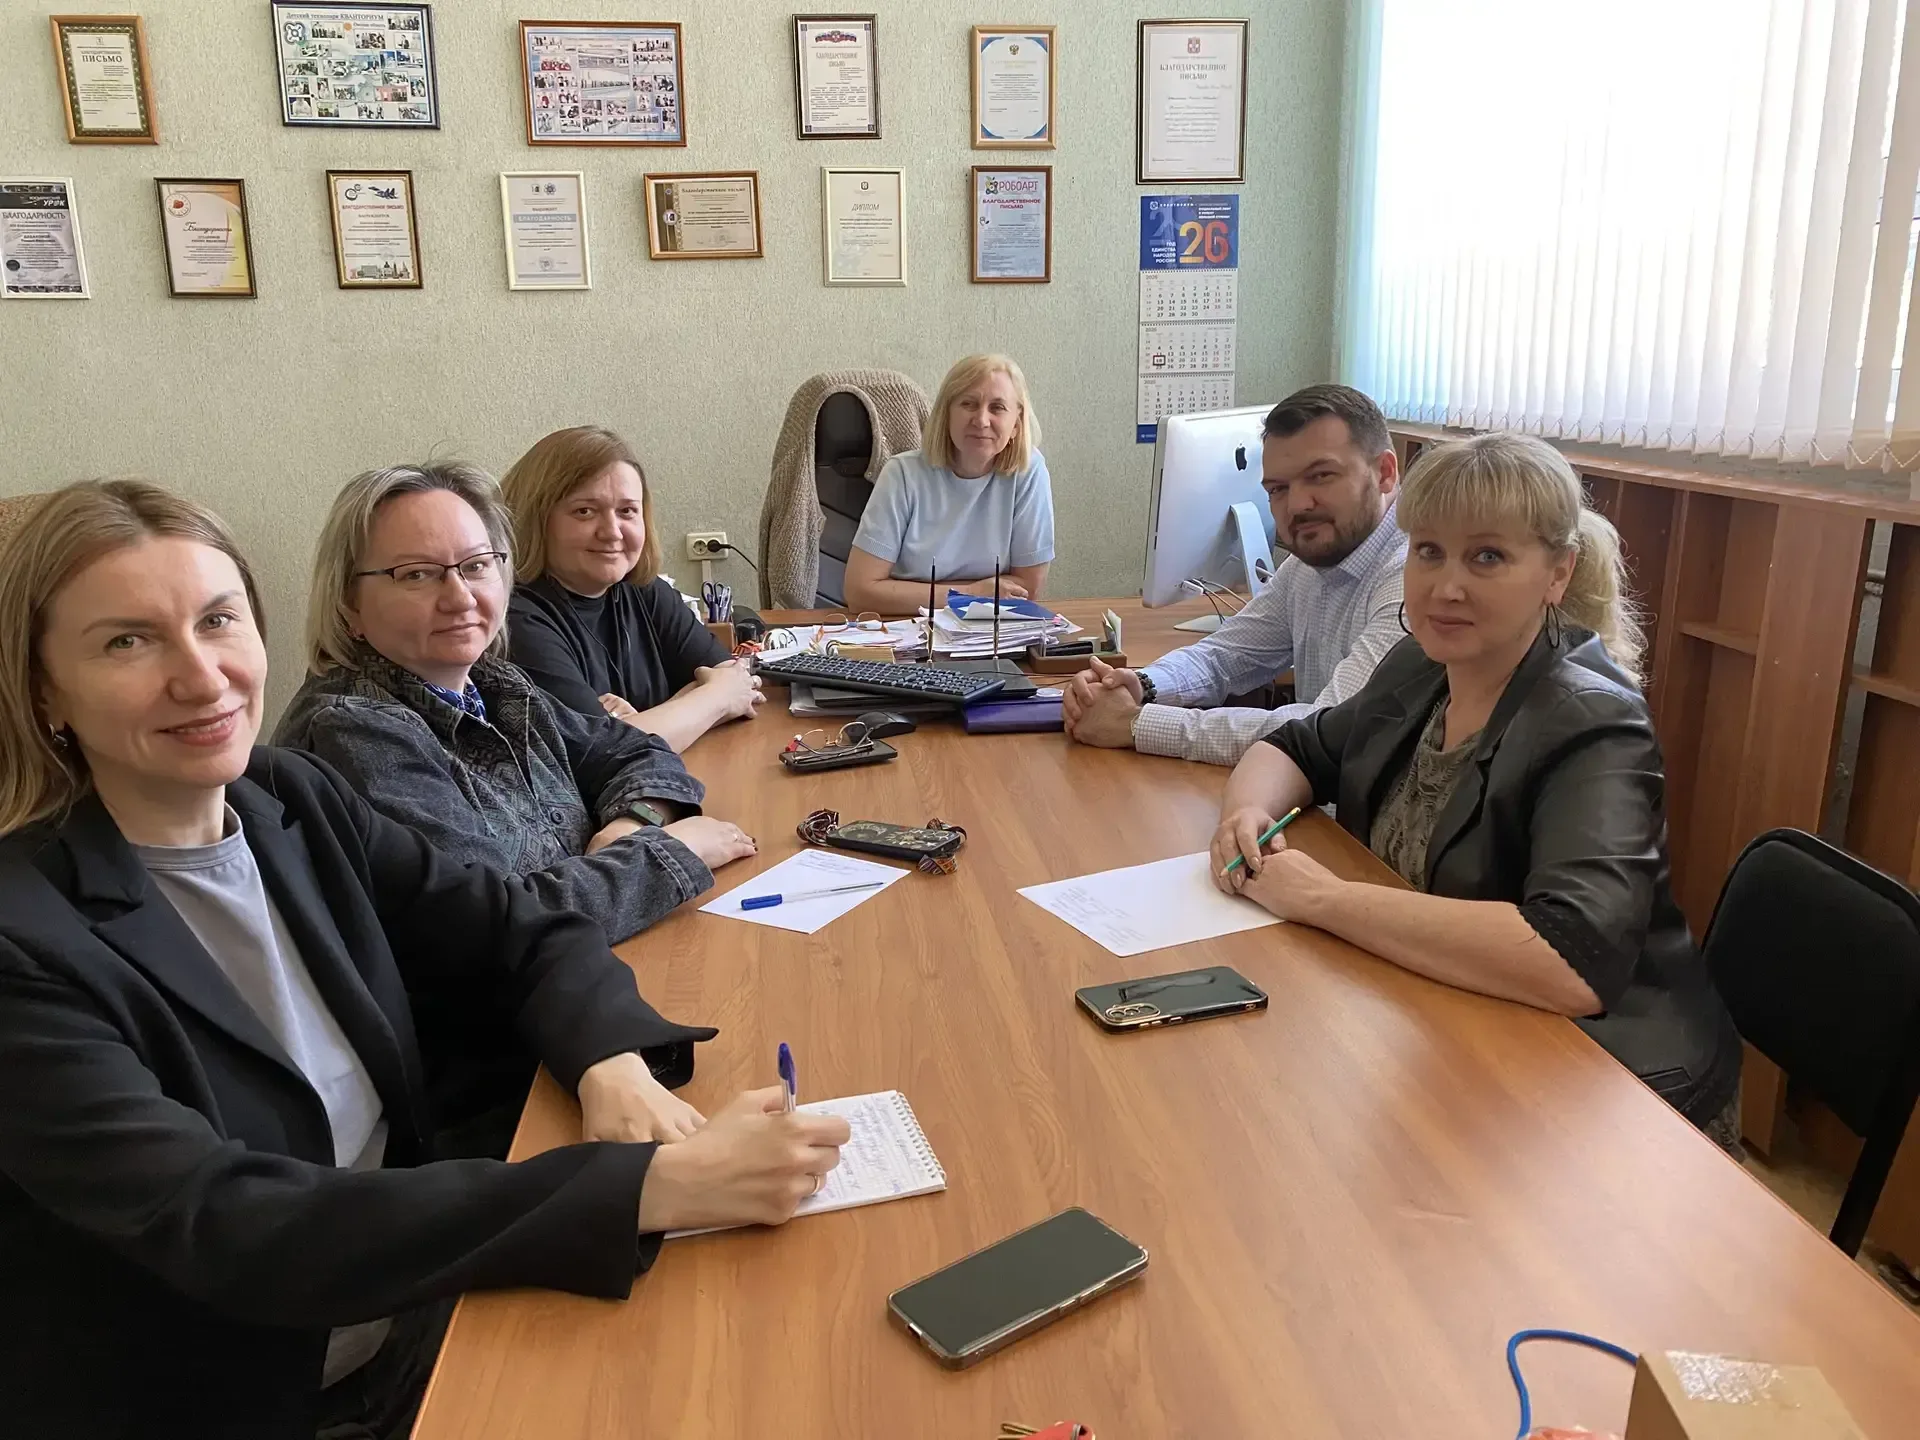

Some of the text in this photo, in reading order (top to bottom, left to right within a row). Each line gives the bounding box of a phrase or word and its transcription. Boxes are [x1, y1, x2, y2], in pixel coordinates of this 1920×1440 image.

[340, 12, 385, 21] КВАНТОРИУМ
[82, 55, 123, 63] ПИСЬМО
[998, 180, 1039, 192] РОБОАРТ
[851, 203, 880, 212] ДИПЛОМ
[2, 211, 66, 220] БЛАГОДАРНОСТЬ
